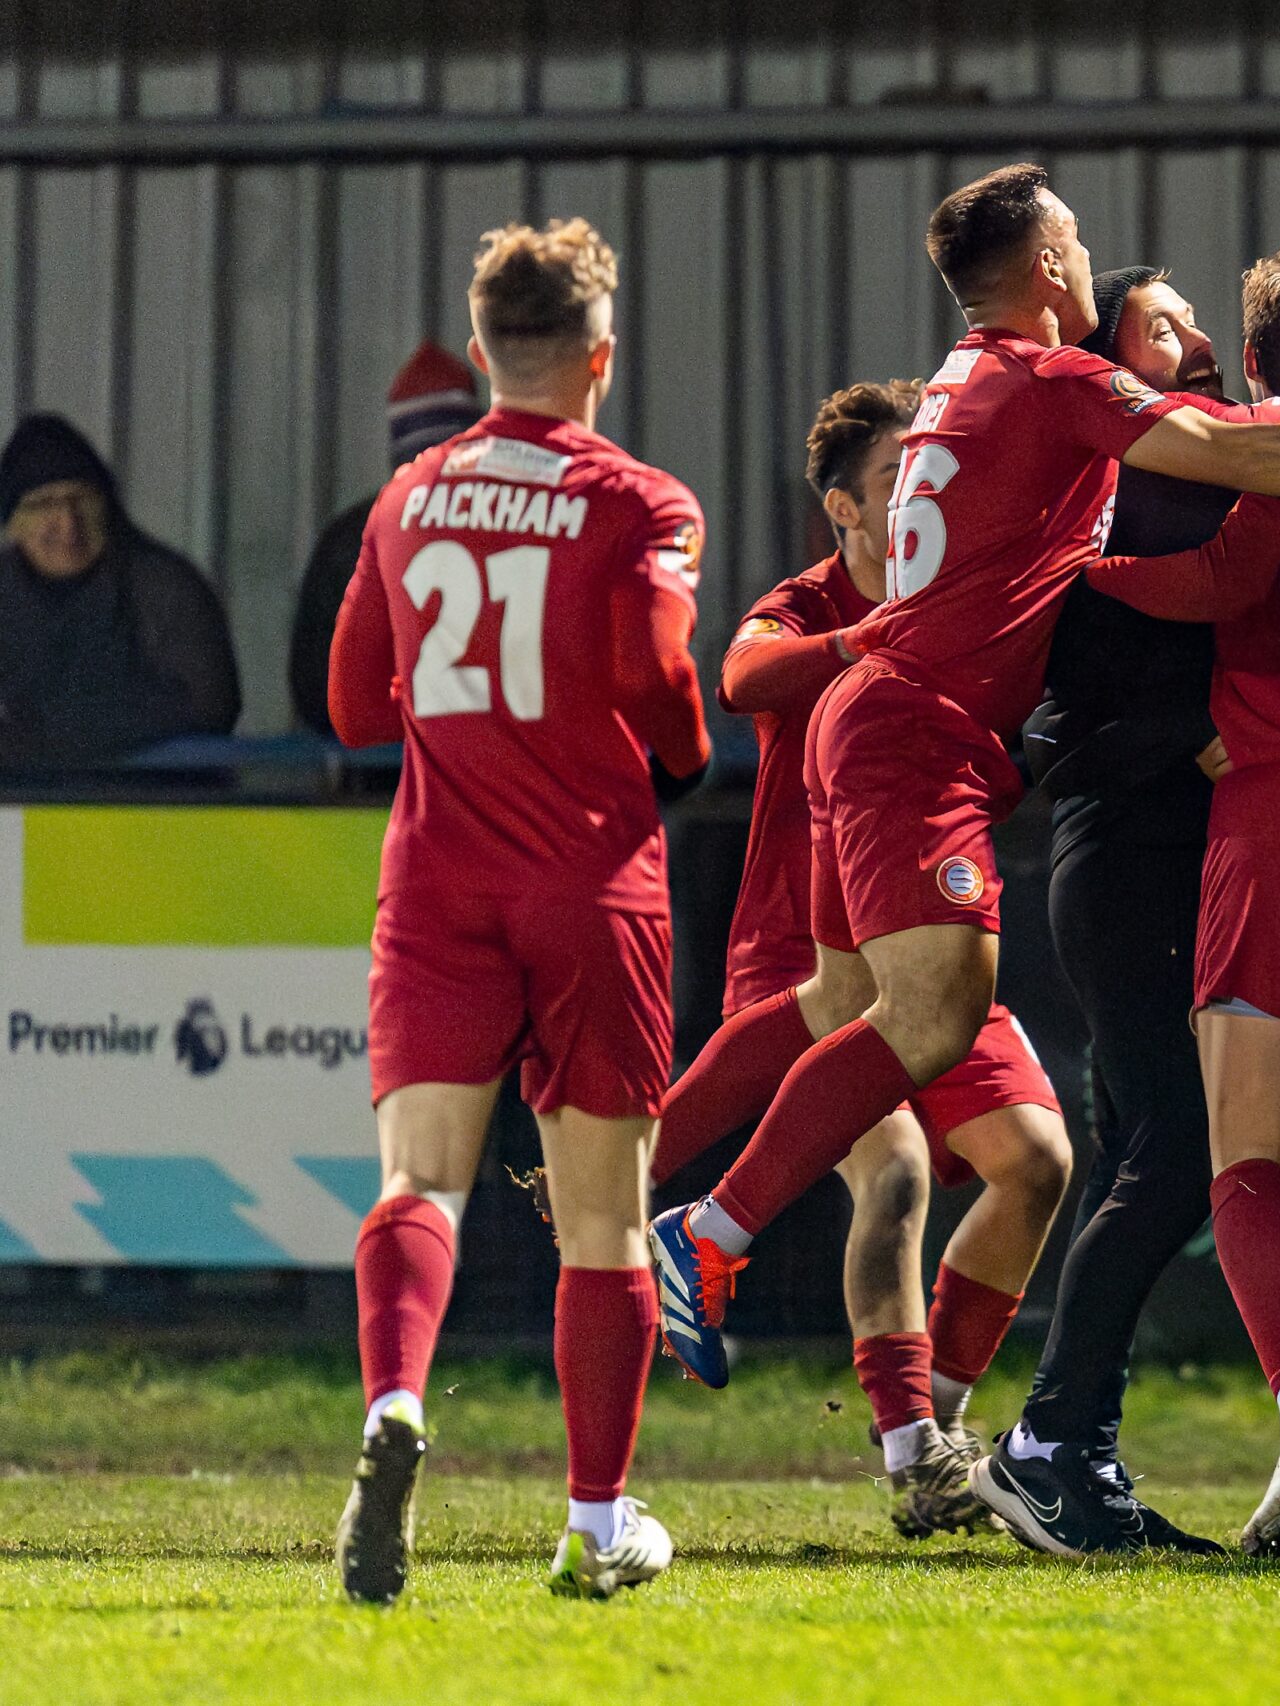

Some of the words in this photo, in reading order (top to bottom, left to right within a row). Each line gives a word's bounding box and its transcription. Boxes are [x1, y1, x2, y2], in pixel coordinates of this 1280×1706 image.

[400, 482, 589, 540] PACKHAM
[401, 539, 550, 722] 21
[8, 1010, 159, 1056] Premier
[239, 1013, 367, 1069] Leagu
